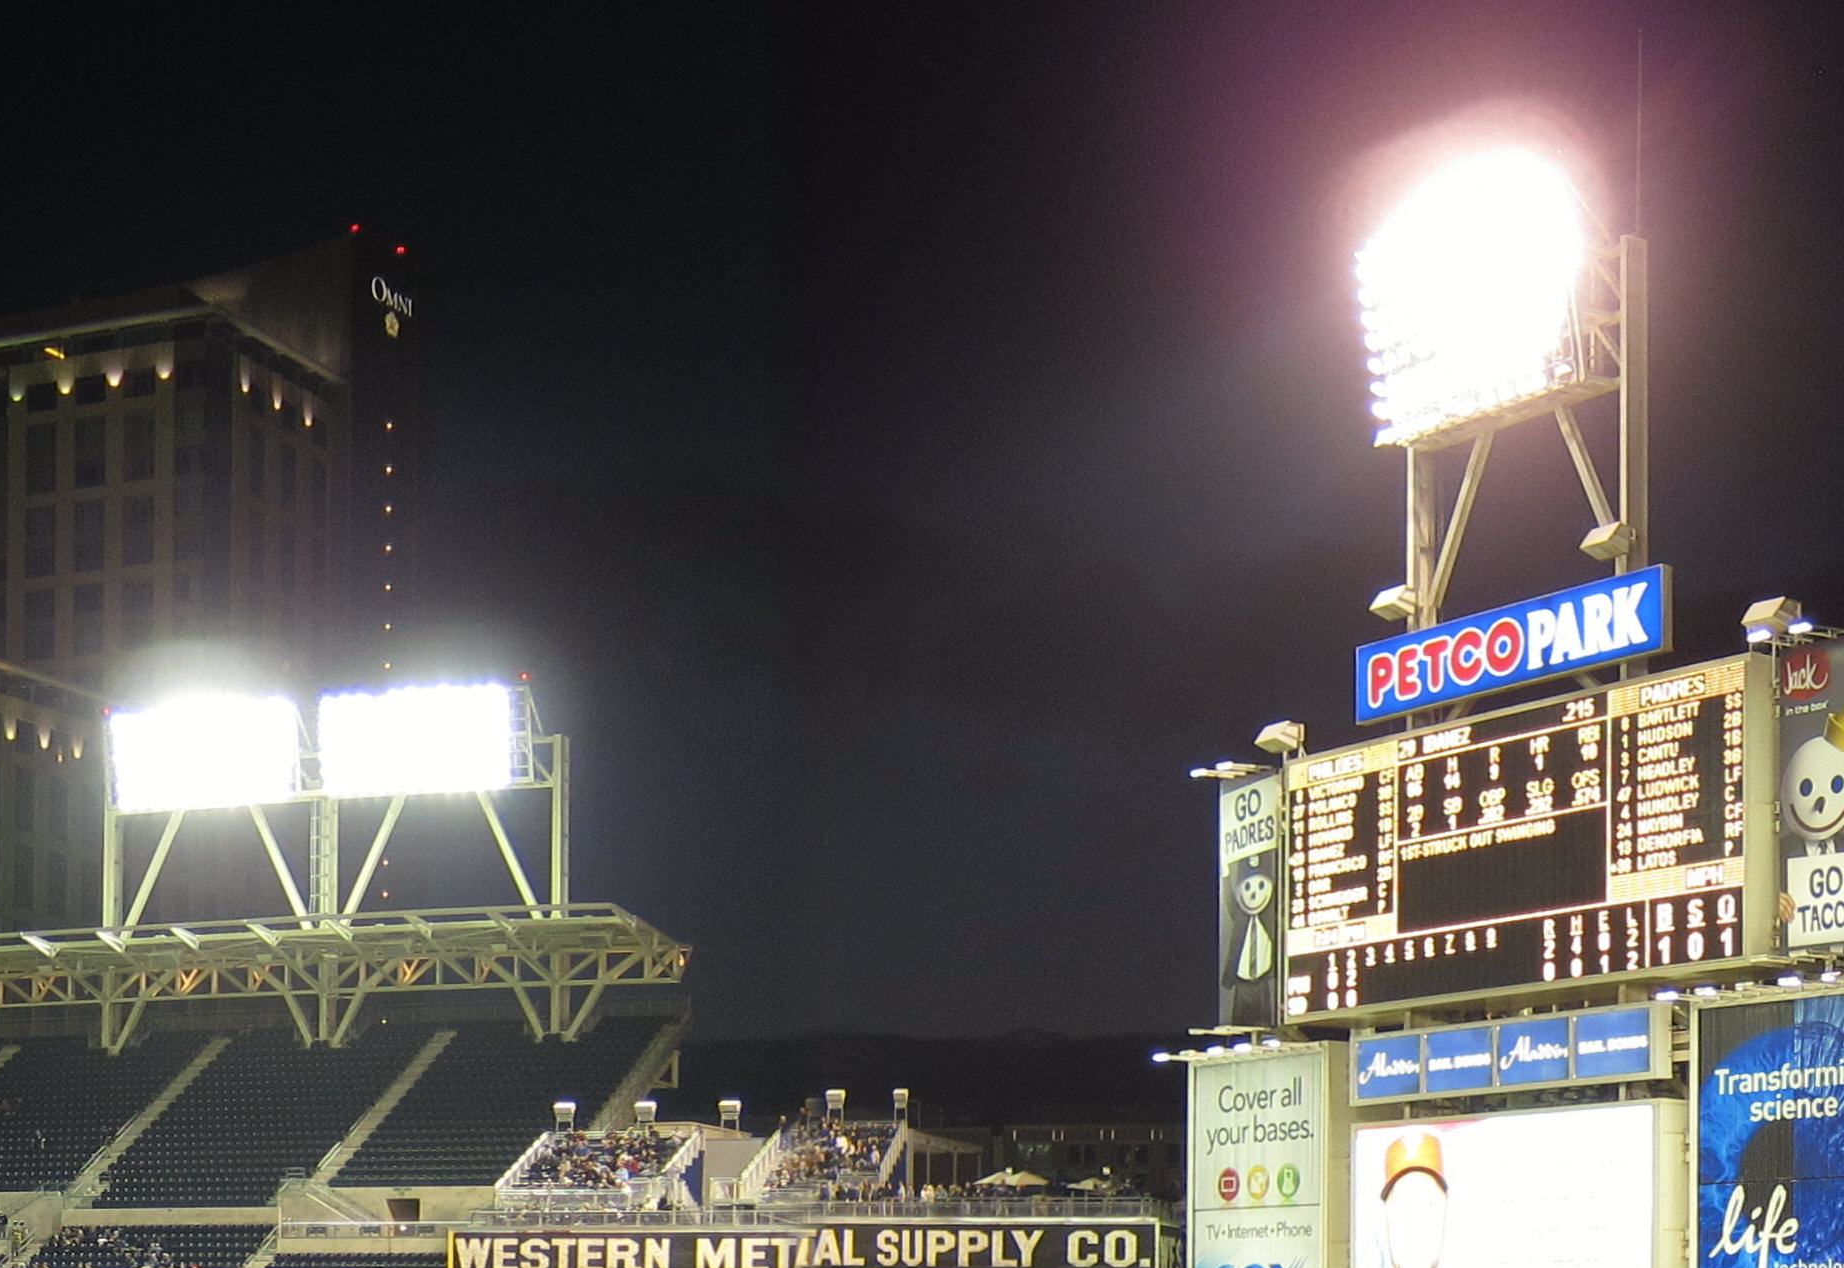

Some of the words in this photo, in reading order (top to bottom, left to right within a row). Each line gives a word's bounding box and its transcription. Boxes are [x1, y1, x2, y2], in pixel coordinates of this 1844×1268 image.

[371, 276, 412, 316] OMNI
[1368, 616, 1524, 709] PETCO
[1526, 581, 1649, 671] PARK
[1640, 674, 1705, 707] PADRES
[1784, 654, 1829, 695] Jack
[1423, 727, 1472, 753] IBANEZ
[1562, 698, 1595, 722] .215
[1637, 702, 1700, 728] BARTLETT
[1725, 694, 1741, 710] SS
[1621, 734, 1629, 749] 1
[1637, 721, 1693, 746] HUDSON
[1723, 711, 1742, 728] 2B
[1405, 763, 1424, 781] AB
[1447, 757, 1458, 773] H
[1489, 747, 1500, 763] R
[1530, 736, 1550, 755] HR
[1578, 725, 1601, 744] RBI
[1620, 752, 1629, 767] 3
[1637, 742, 1679, 763] CANTU
[1723, 730, 1742, 746] 1B
[1637, 757, 1696, 781] HEADLEY
[1723, 749, 1742, 765] 3B
[1479, 788, 1506, 808] OBP
[1526, 778, 1555, 798] SLG
[1571, 768, 1600, 789] OPS
[1637, 774, 1700, 799] LUDWICK
[1724, 766, 1742, 783] LF
[1235, 789, 1261, 822] GO
[1637, 792, 1700, 817] HUNDLEY
[1724, 786, 1735, 801] C
[1225, 815, 1274, 854] PADRES
[1470, 830, 1493, 847] OUT
[1496, 819, 1555, 843] SWINGING
[1637, 813, 1683, 835] MAYBIN
[1724, 803, 1743, 820] CF
[1637, 828, 1704, 853] DENORFIA
[1724, 821, 1743, 838] RF
[1637, 851, 1677, 871] LATOS
[1724, 840, 1734, 857] P
[1686, 863, 1724, 889] MPH
[1809, 866, 1843, 898] GO
[1687, 898, 1704, 925] S
[1657, 935, 1670, 964] 1
[1687, 931, 1704, 960] 0
[1720, 927, 1733, 956] 1
[1218, 1084, 1277, 1114] Cover
[1281, 1076, 1302, 1107] all
[1749, 1094, 1839, 1122] science
[1206, 1124, 1249, 1155] your
[1253, 1115, 1315, 1144] bases.
[1276, 1221, 1313, 1238] Phone
[876, 1229, 1044, 1268] SUPPLY
[1068, 1230, 1151, 1268] CO.
